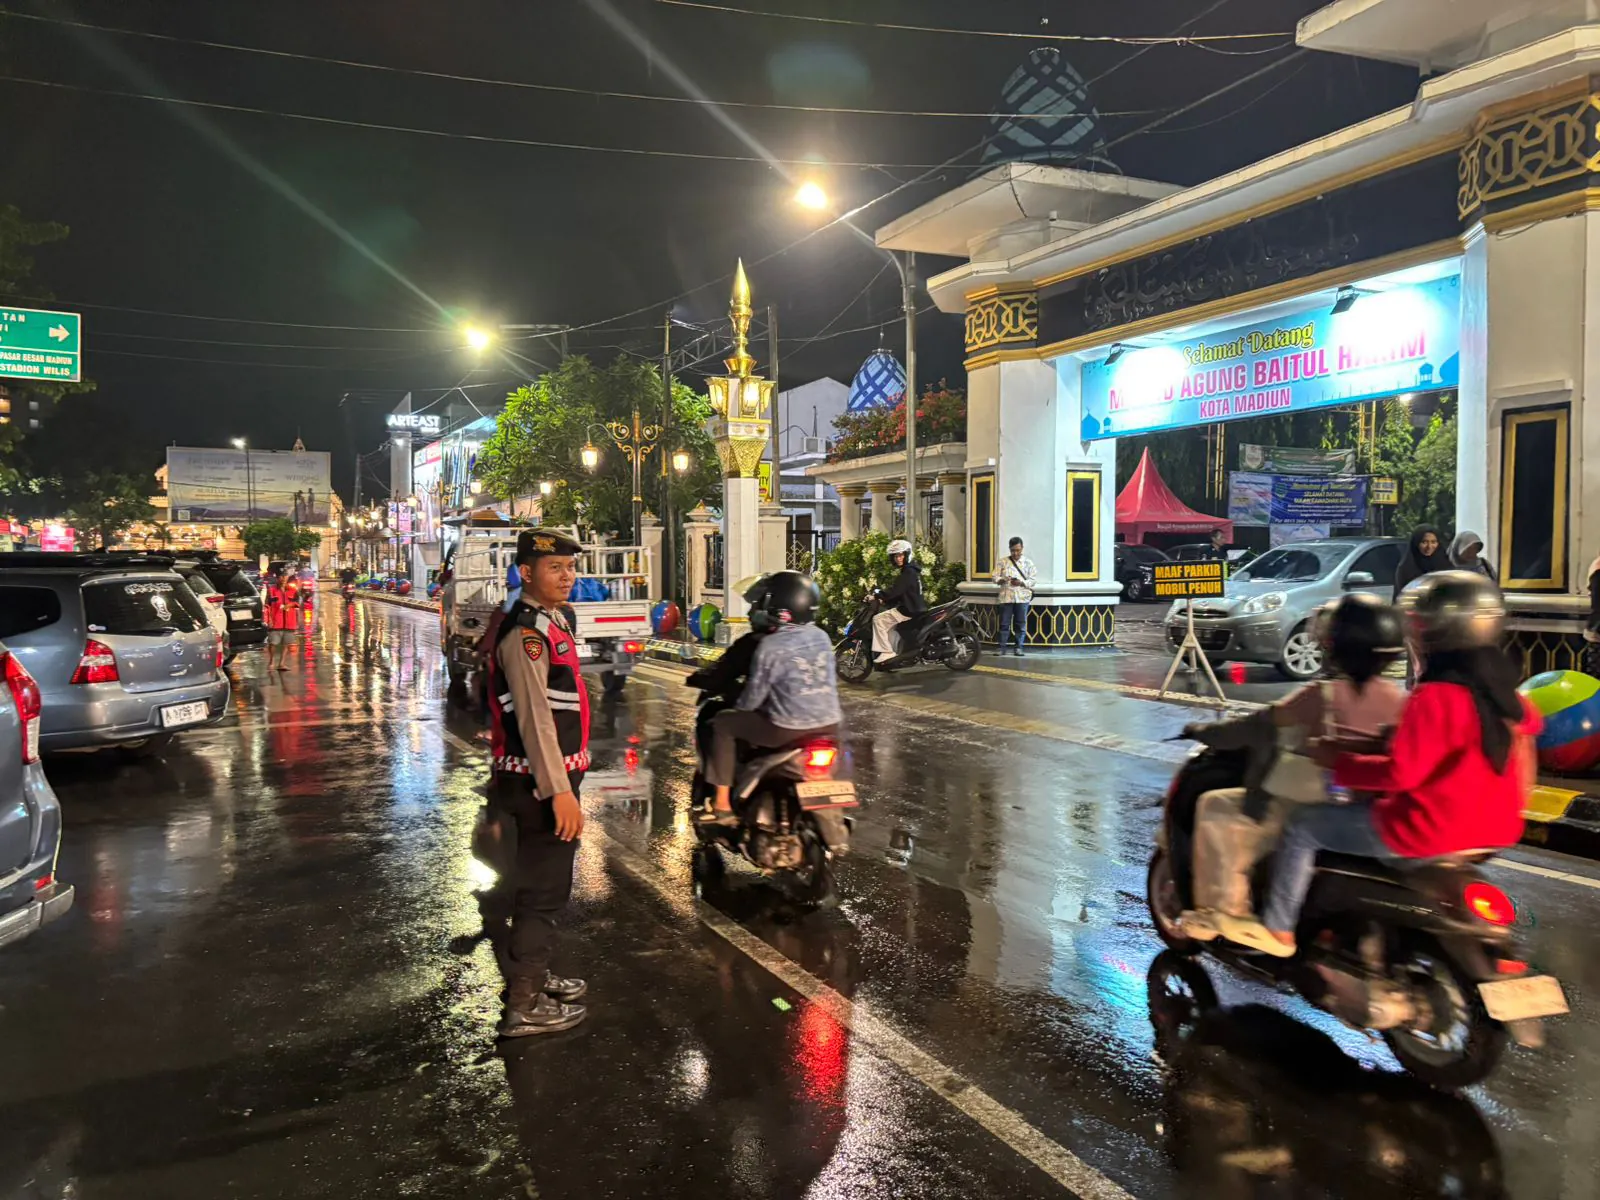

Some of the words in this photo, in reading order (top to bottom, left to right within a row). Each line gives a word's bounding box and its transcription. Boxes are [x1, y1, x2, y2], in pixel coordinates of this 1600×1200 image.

[1183, 336, 1245, 369] Selamat
[1246, 320, 1315, 354] Datang
[0, 363, 40, 374] STADION
[43, 366, 70, 376] WILIS
[1180, 364, 1248, 398] AGUNG
[1254, 349, 1329, 386] BAITUL
[1200, 398, 1230, 418] KOTA
[1235, 388, 1291, 413] MADIUN
[387, 414, 441, 427] ARTEAST
[1155, 565, 1183, 578] MAAF
[1184, 564, 1221, 577] PARKIR
[1156, 582, 1187, 596] MOBIL
[1188, 580, 1222, 594] PENUH
